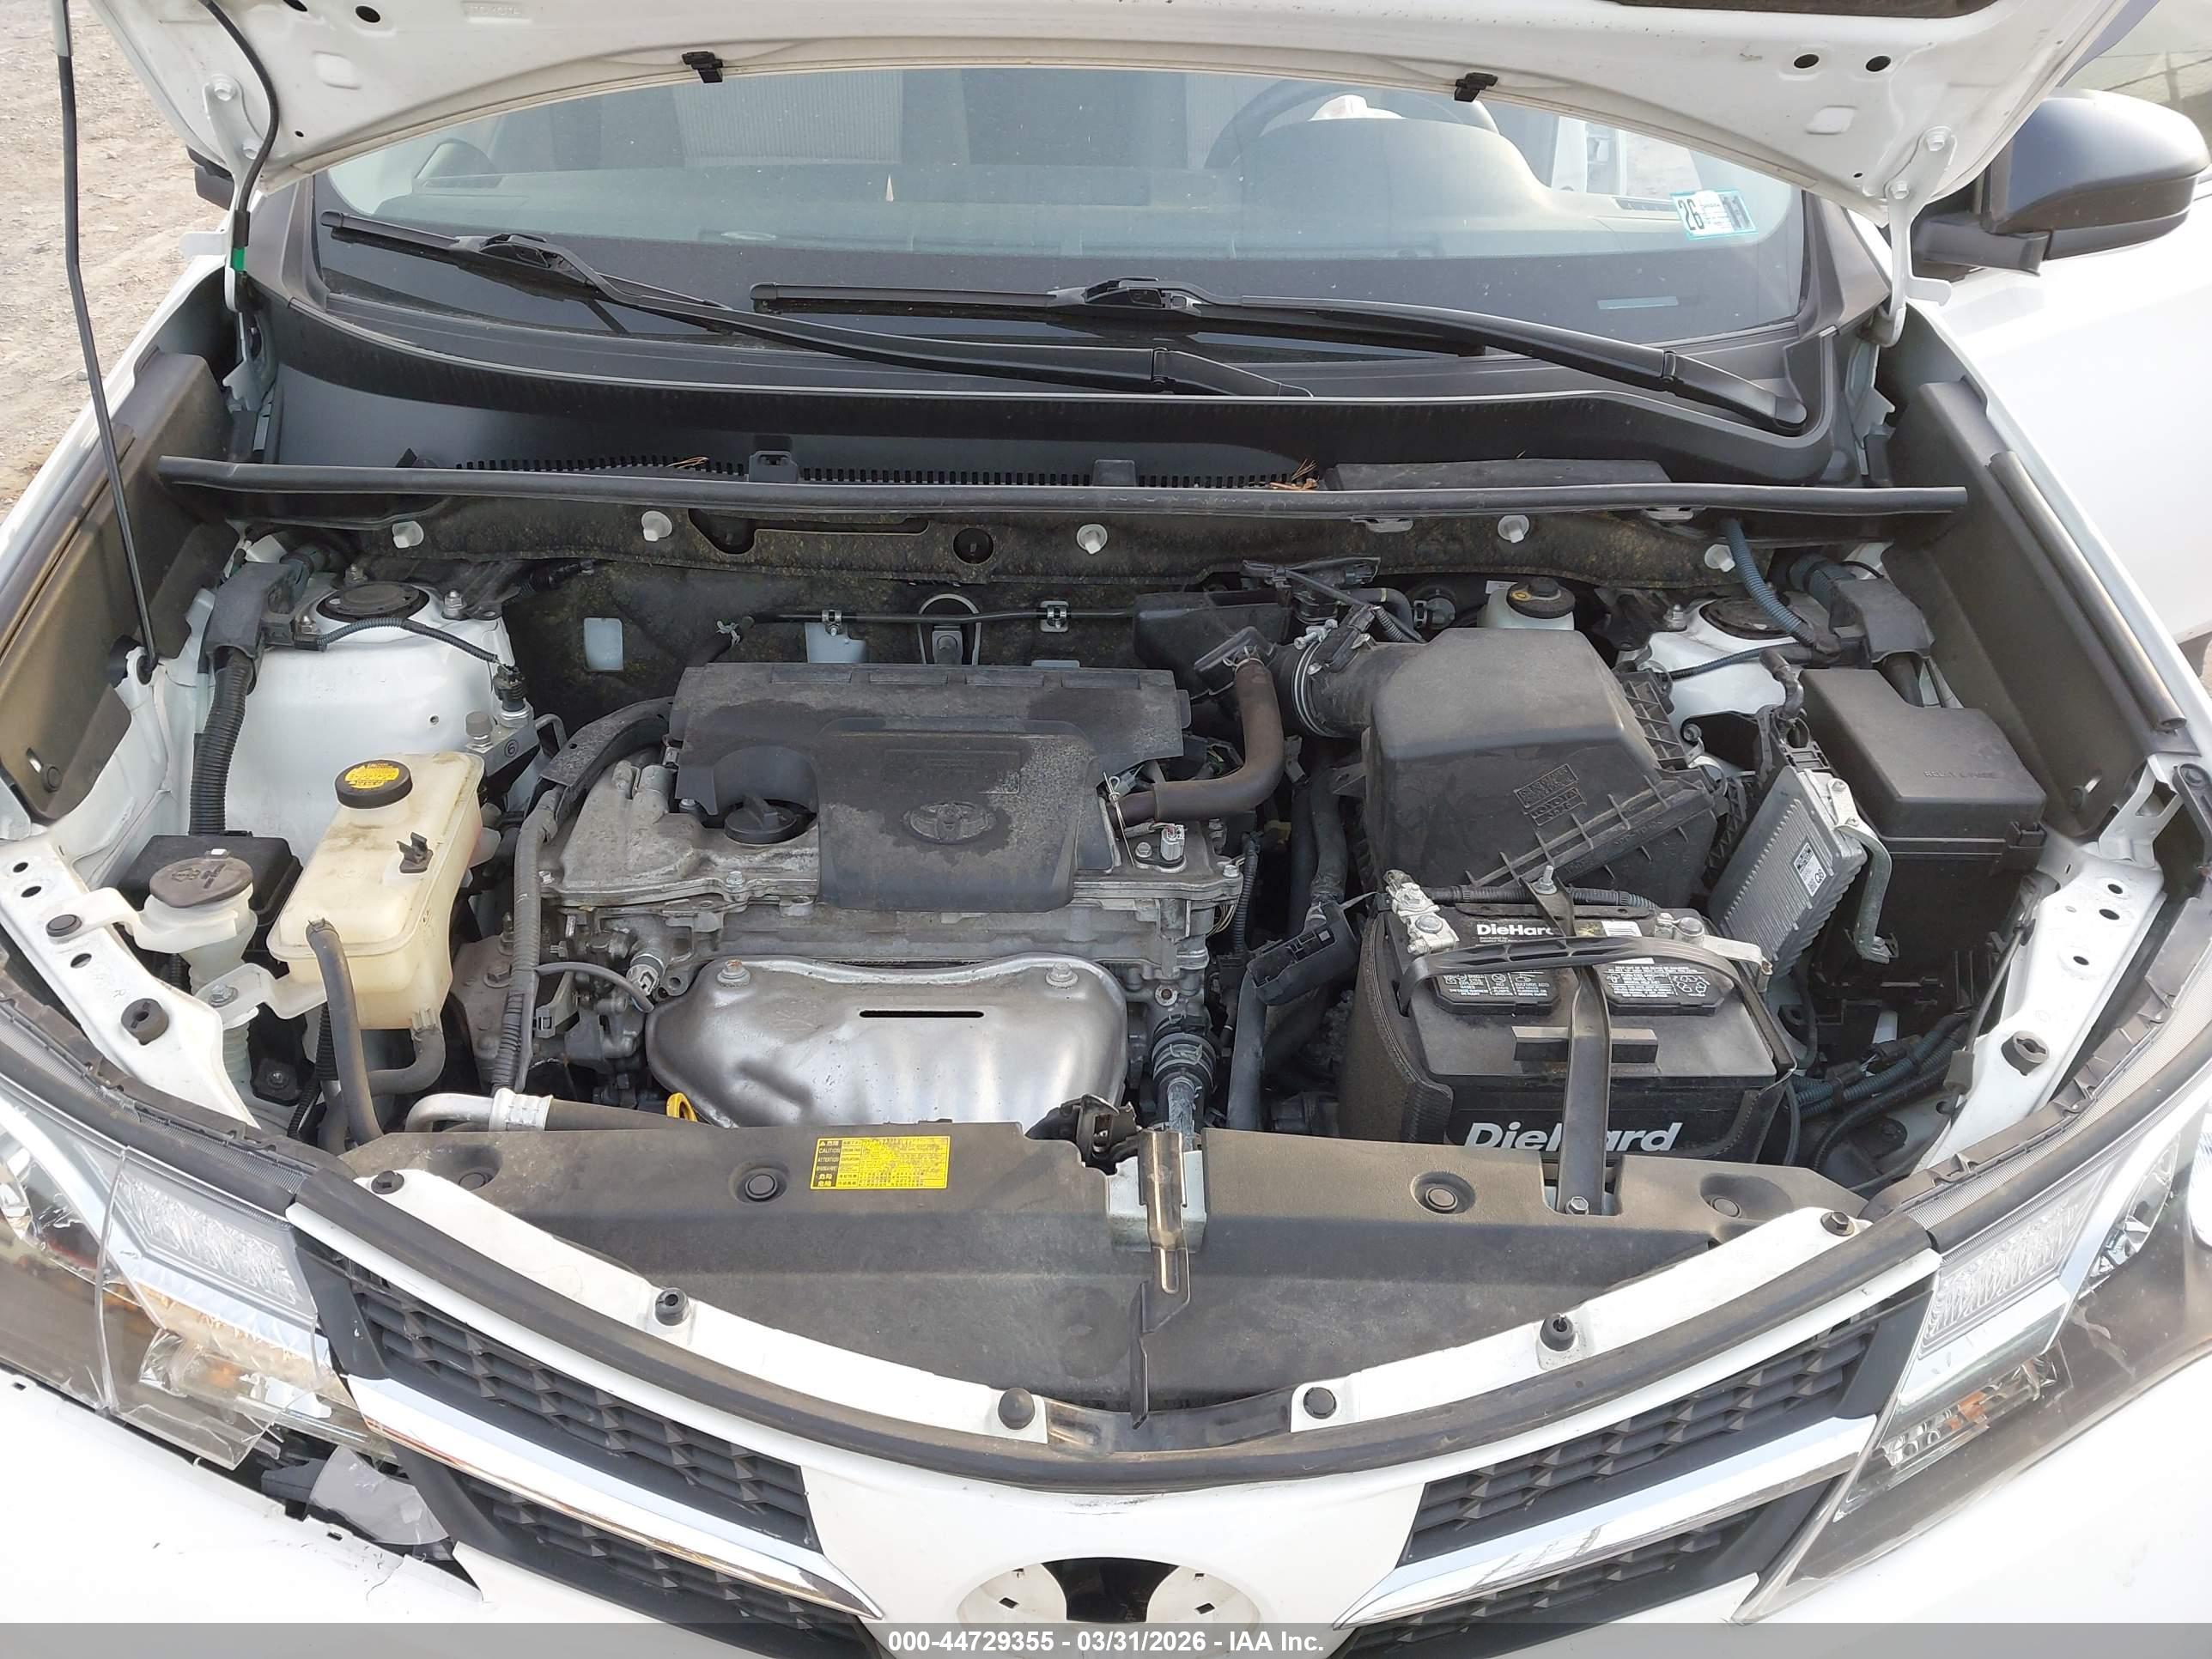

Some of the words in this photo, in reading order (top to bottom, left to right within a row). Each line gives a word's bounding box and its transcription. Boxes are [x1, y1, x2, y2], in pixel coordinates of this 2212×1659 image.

[1677, 198, 1705, 230] 26
[506, 741, 517, 756] 6
[1464, 1121, 1683, 1152] Dierd
